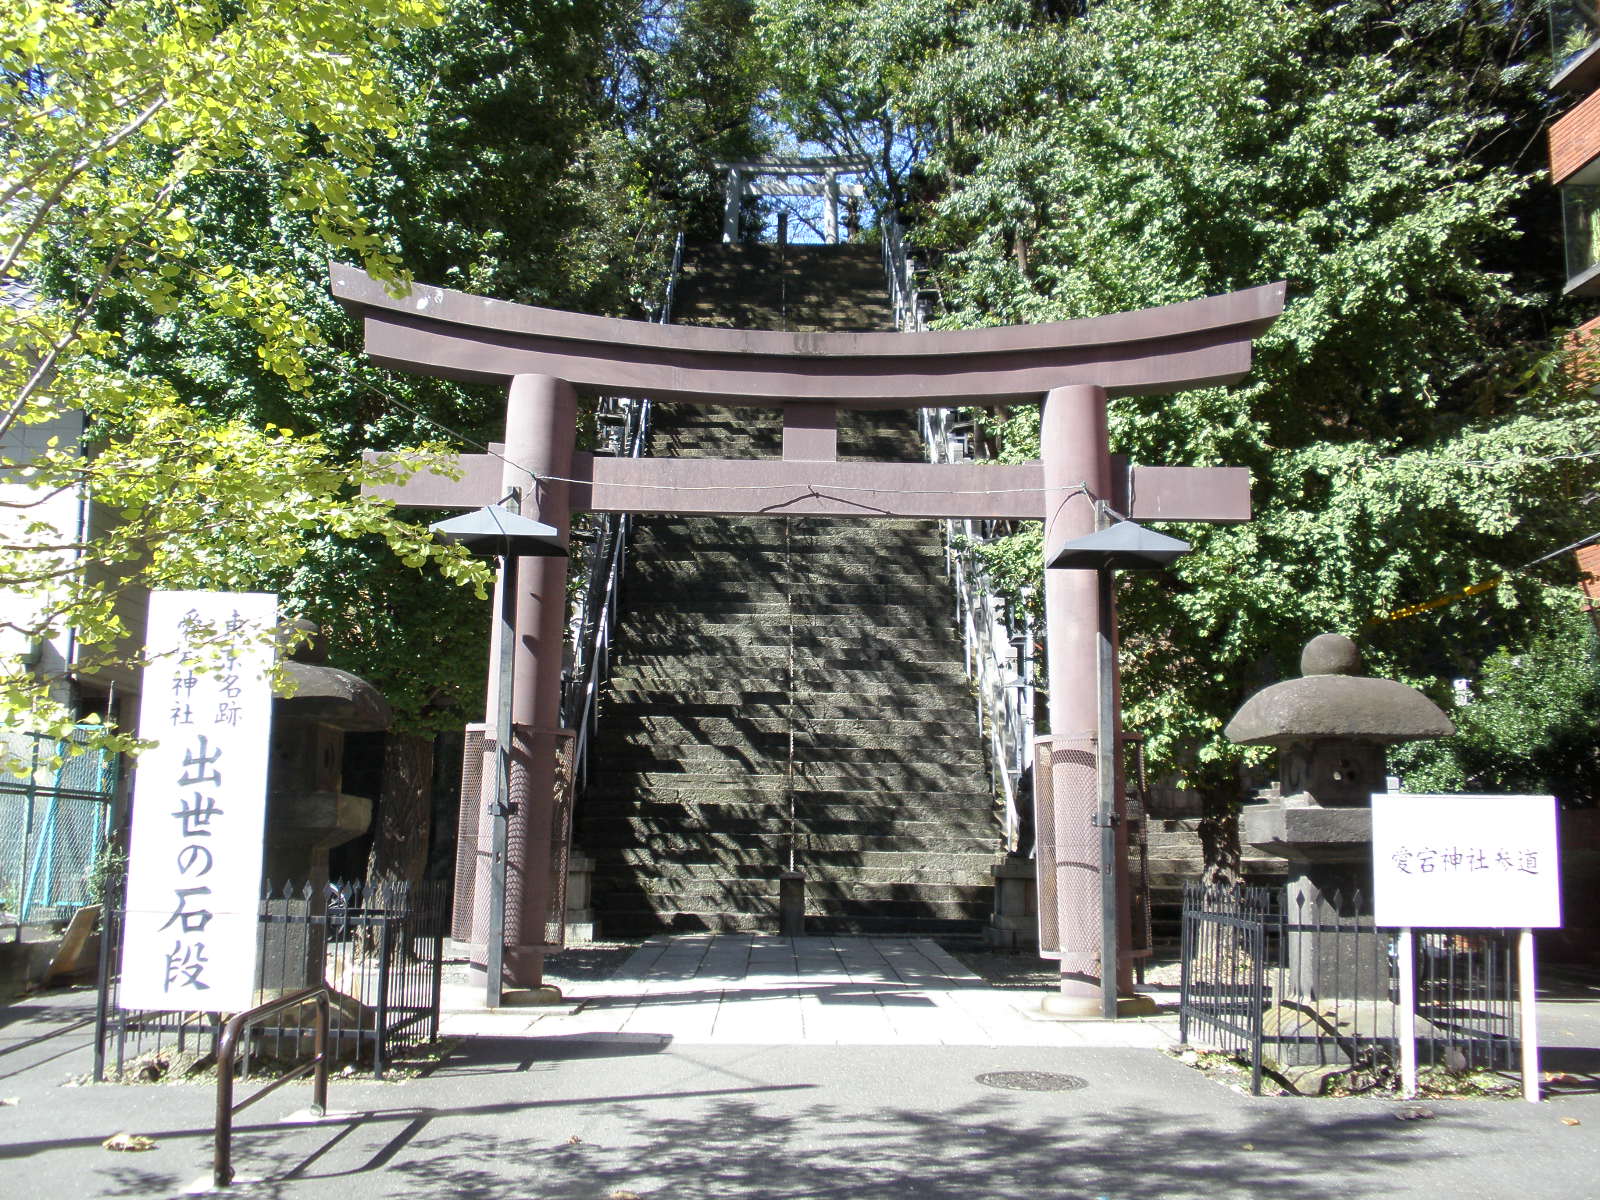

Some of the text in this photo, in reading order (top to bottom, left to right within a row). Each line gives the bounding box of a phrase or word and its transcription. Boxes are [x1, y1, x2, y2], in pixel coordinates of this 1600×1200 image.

[160, 735, 224, 993] 出世の石段
[1391, 846, 1539, 875] 愛宕神社参道
